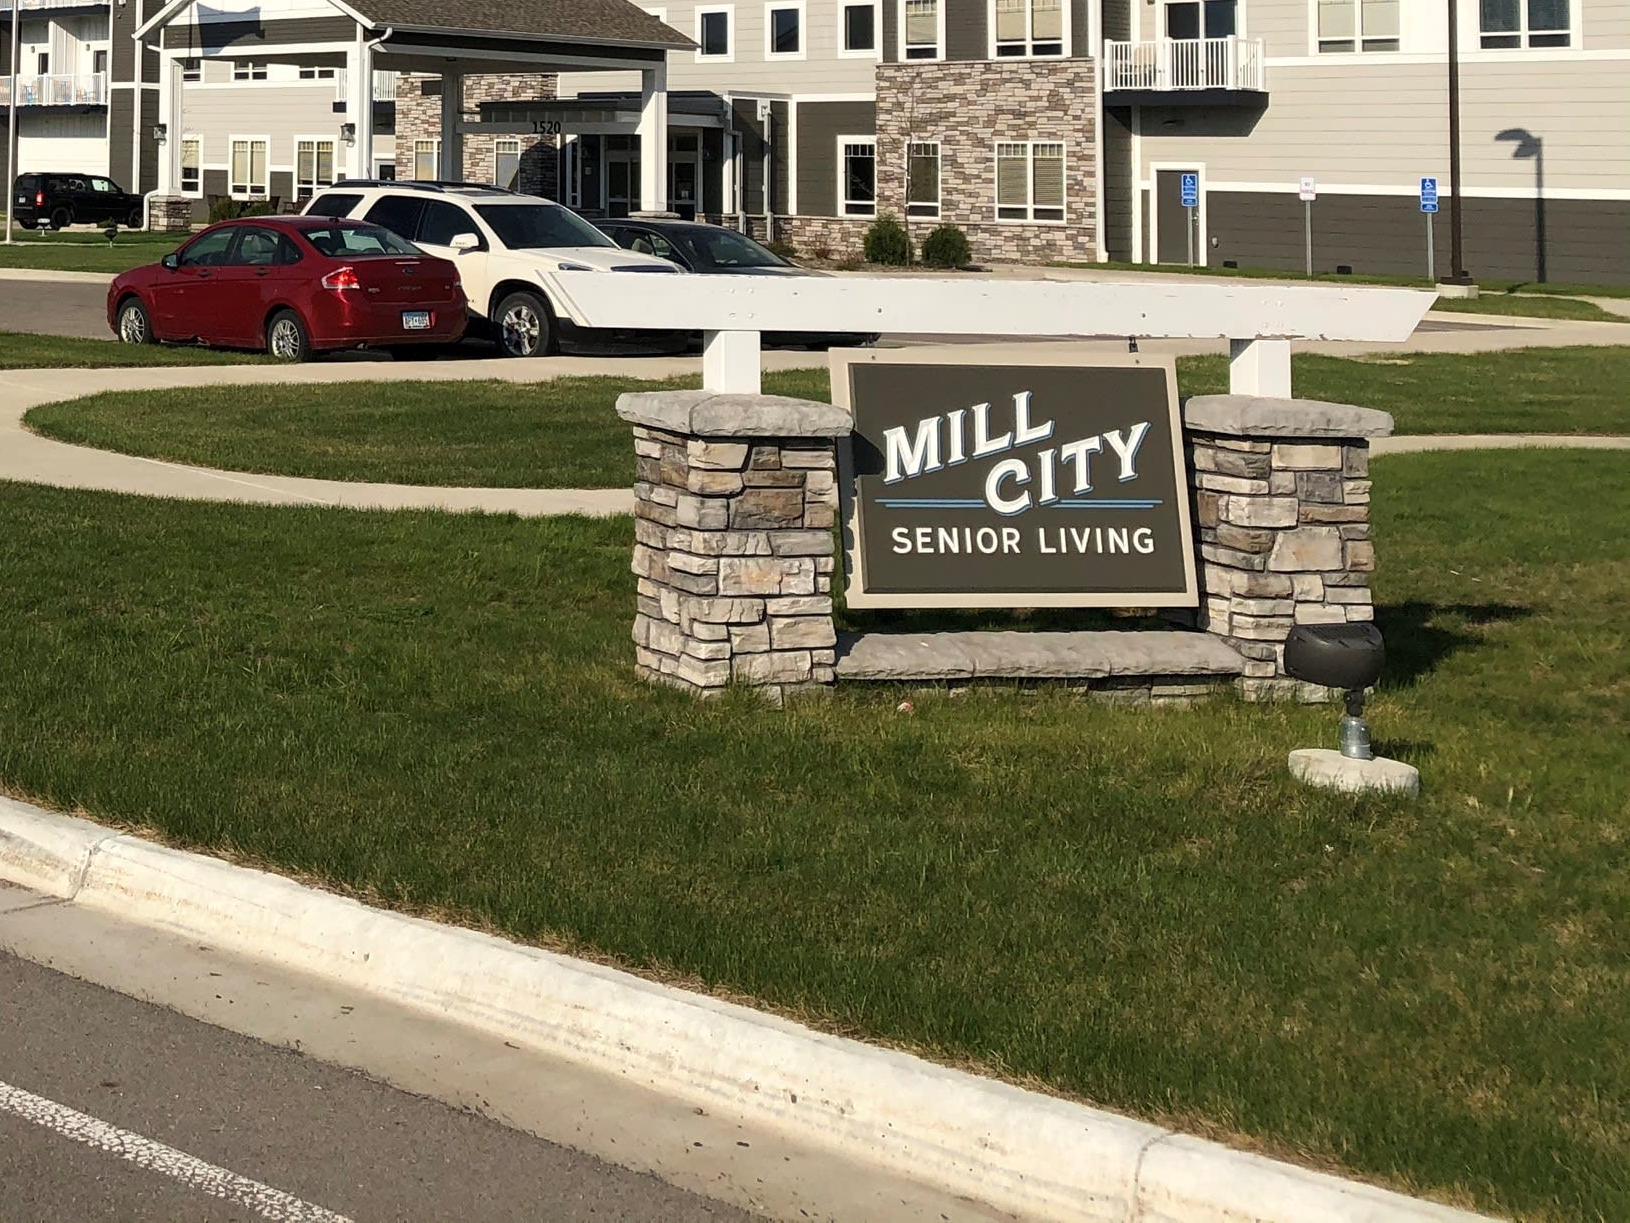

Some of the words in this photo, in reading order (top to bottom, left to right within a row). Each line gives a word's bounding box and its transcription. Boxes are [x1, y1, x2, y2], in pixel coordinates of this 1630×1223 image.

[532, 120, 561, 134] 1520
[883, 390, 1055, 485] MILL
[985, 421, 1152, 516] CITY
[892, 527, 1021, 554] SENIOR
[1039, 527, 1155, 554] LIVING
